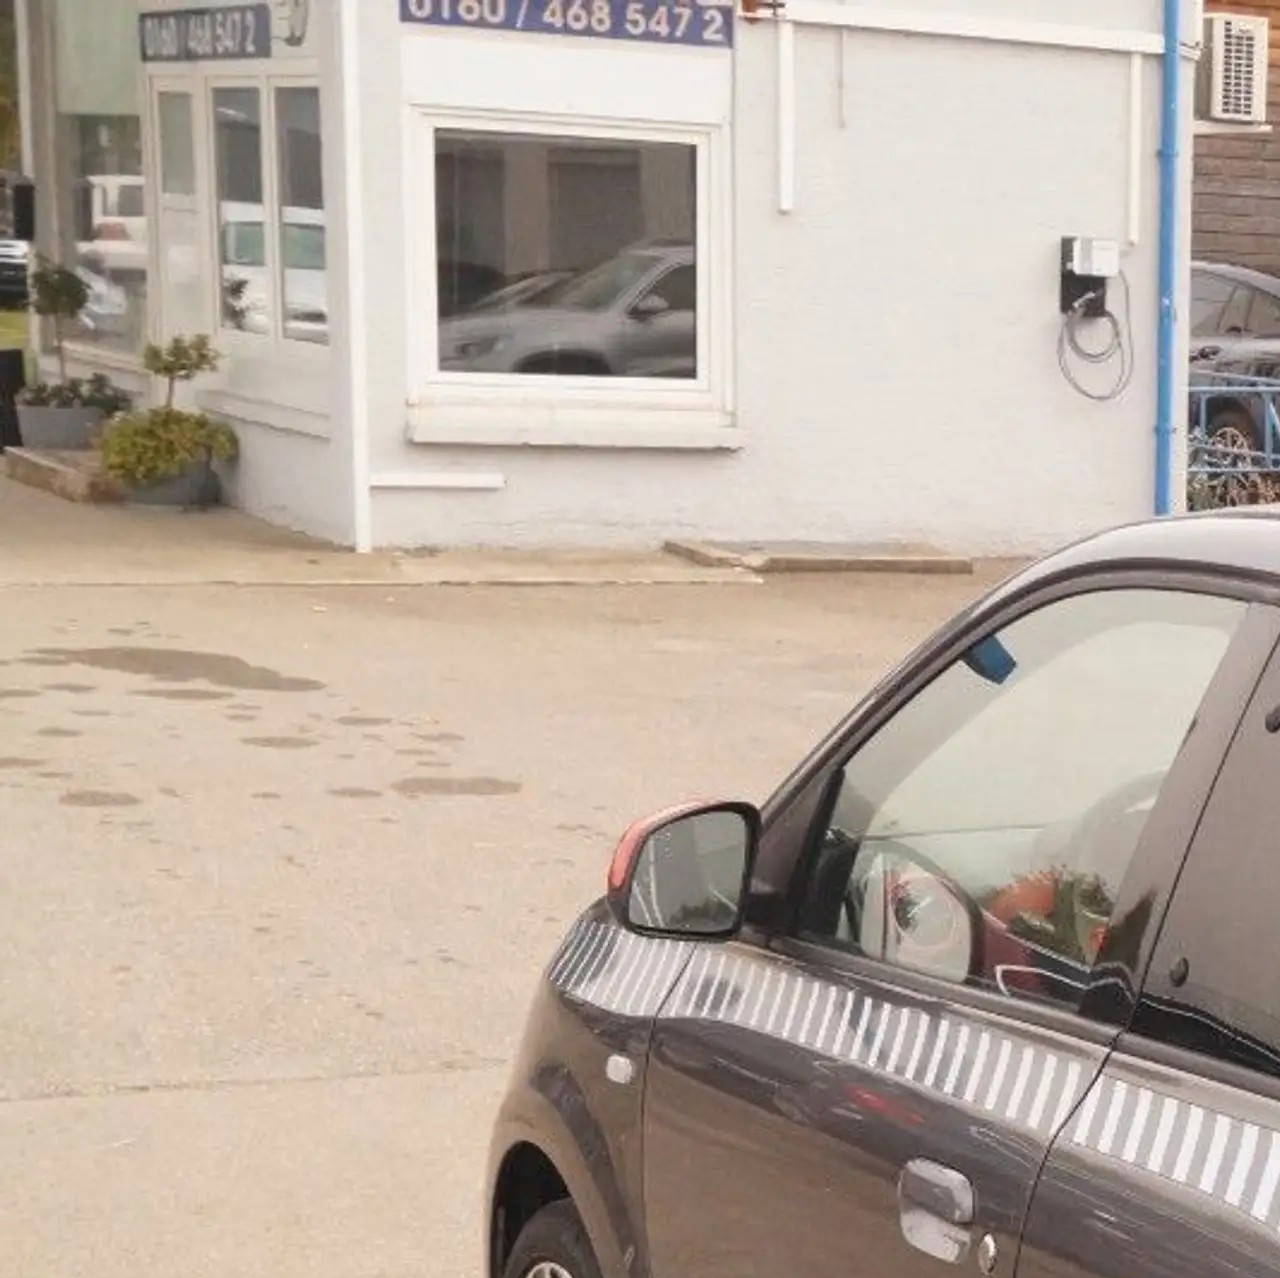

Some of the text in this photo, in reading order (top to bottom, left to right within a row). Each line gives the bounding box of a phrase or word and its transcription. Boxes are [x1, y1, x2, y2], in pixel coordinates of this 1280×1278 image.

[409, 0, 504, 24] 0160
[542, 0, 612, 33] 468
[625, 2, 692, 38] 547
[702, 9, 724, 42] 2
